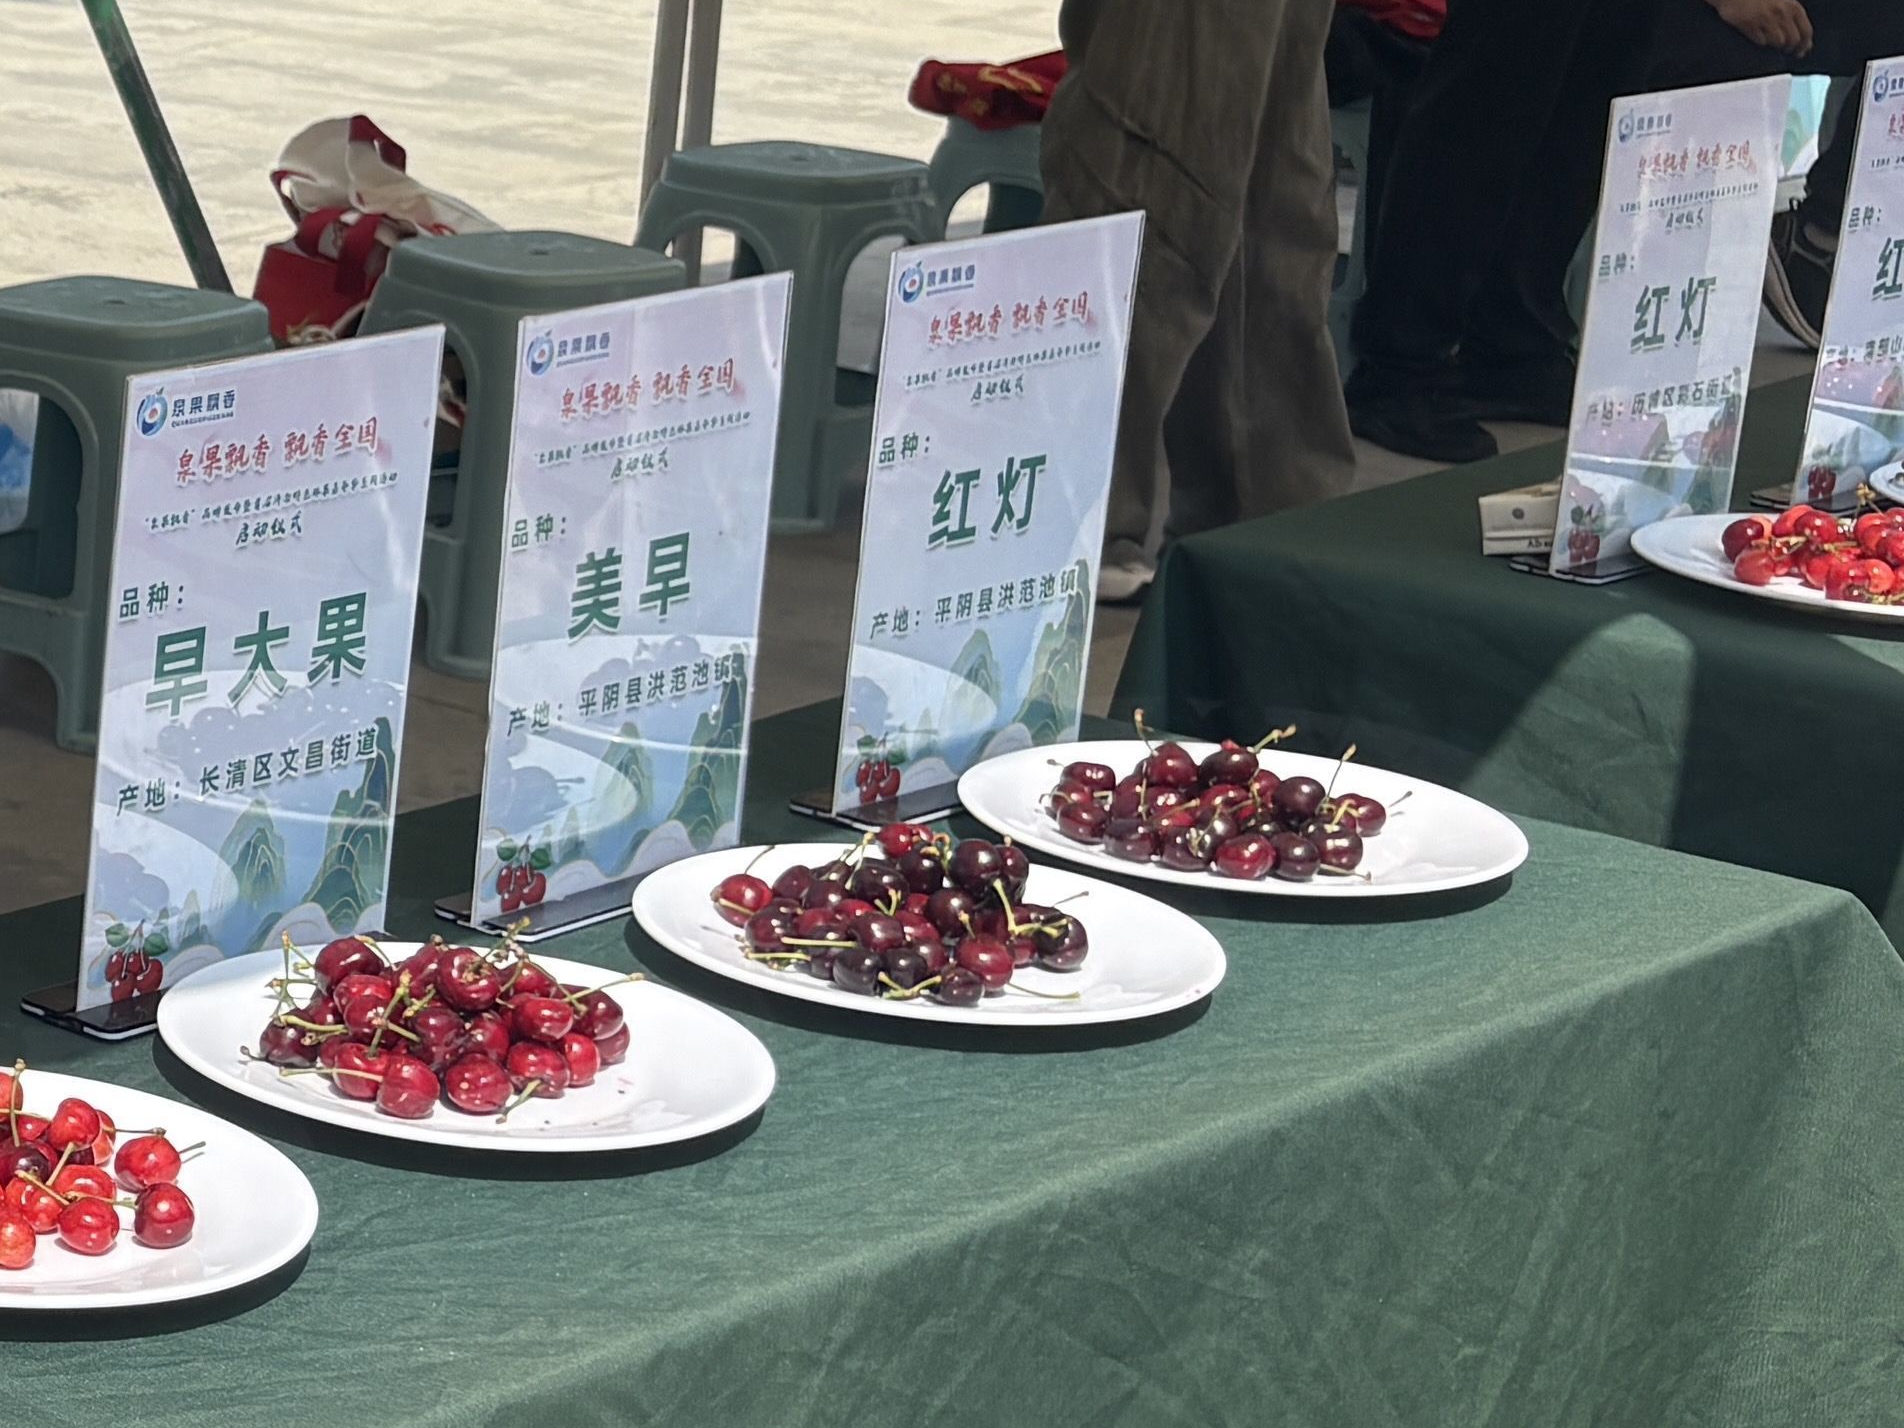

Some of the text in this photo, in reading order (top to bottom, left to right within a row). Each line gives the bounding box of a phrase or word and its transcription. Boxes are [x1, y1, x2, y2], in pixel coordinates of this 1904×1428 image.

[1630, 276, 1717, 348] 红灯
[177, 417, 378, 483] 泉果飘香 飘香全国
[878, 433, 932, 464] 品种：
[236, 511, 303, 546] 启动仪式
[512, 513, 566, 548] 品种：
[928, 453, 1047, 545] 红灯
[119, 581, 187, 619] 品种：
[567, 532, 690, 639] 美早
[146, 591, 368, 717] 早大果
[507, 654, 732, 736] 产地：平阴县洪范池镇
[117, 727, 378, 816] 产地：长清区文昌街道
